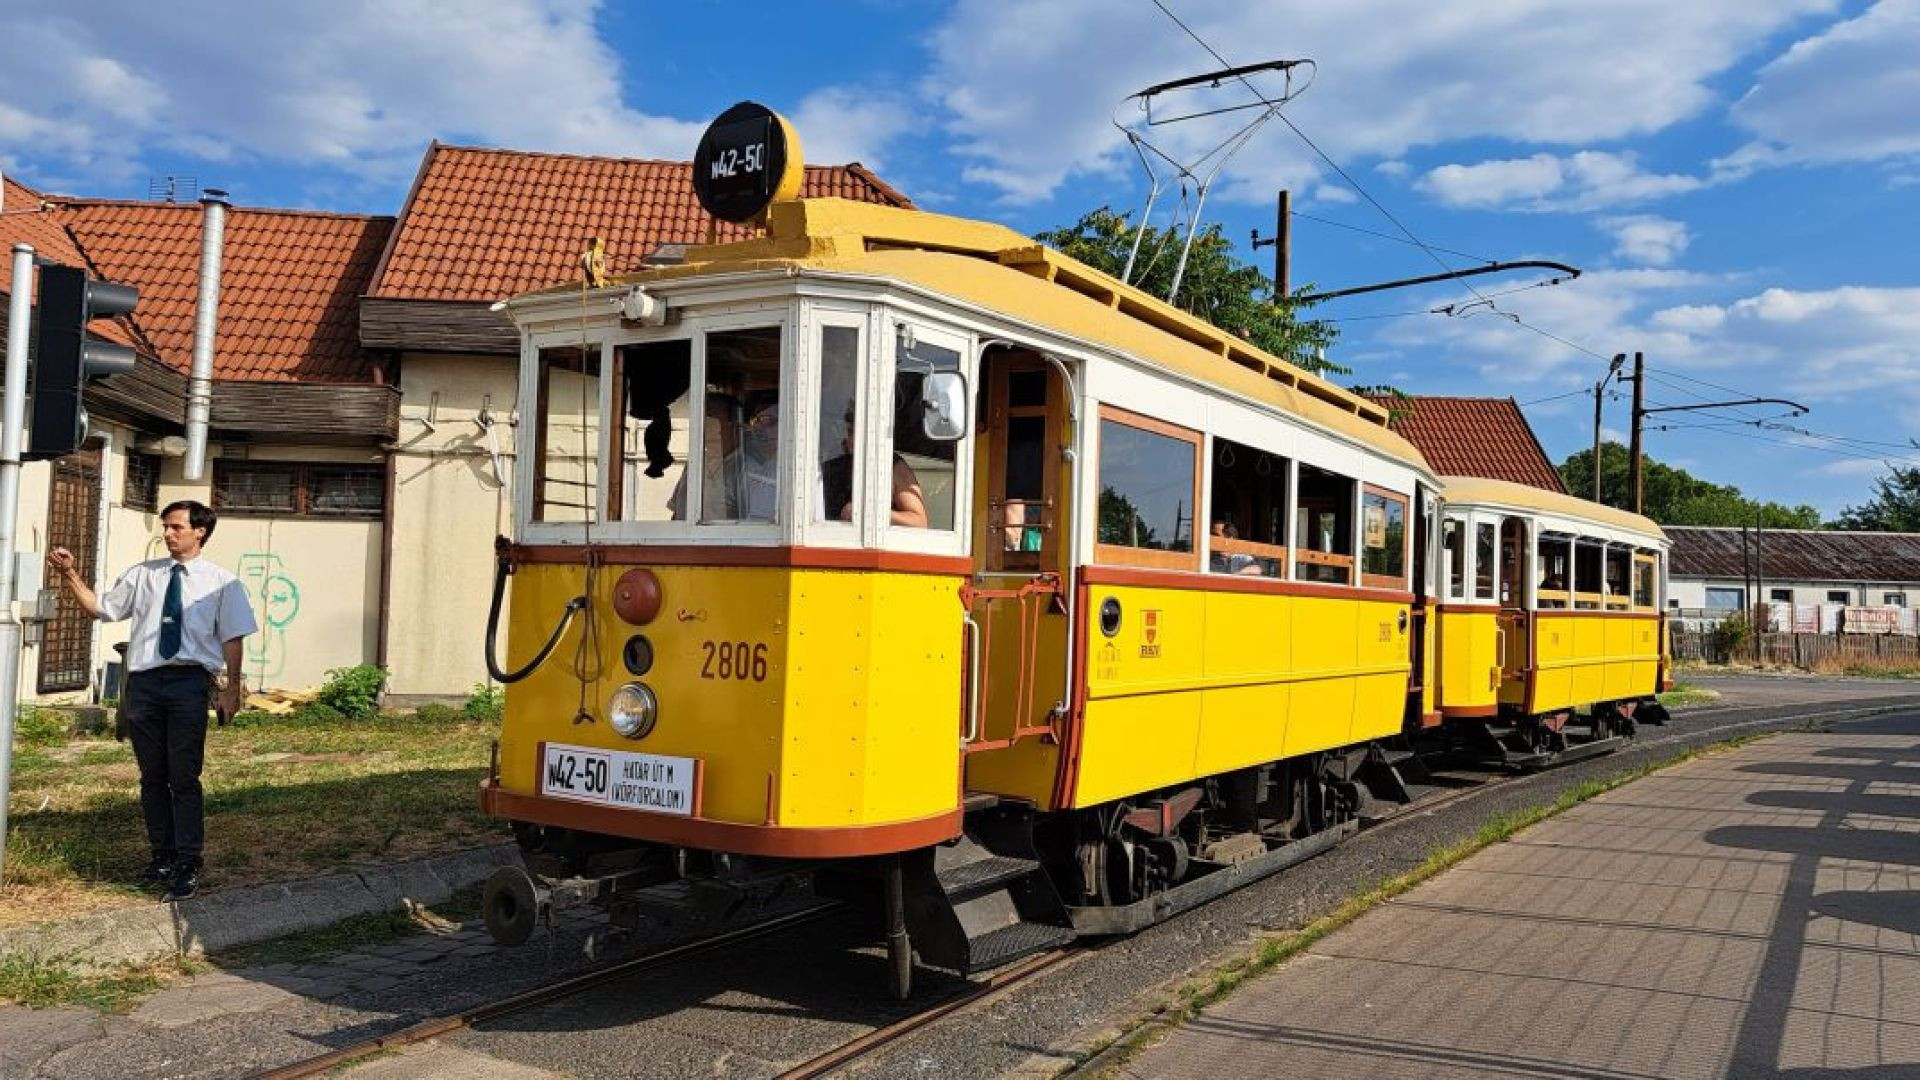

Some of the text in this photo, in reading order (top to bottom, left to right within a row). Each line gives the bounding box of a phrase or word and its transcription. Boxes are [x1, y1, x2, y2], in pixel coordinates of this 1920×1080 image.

[701, 641, 768, 682] 2806
[652, 759, 665, 783] ÚT
[667, 764, 674, 784] M
